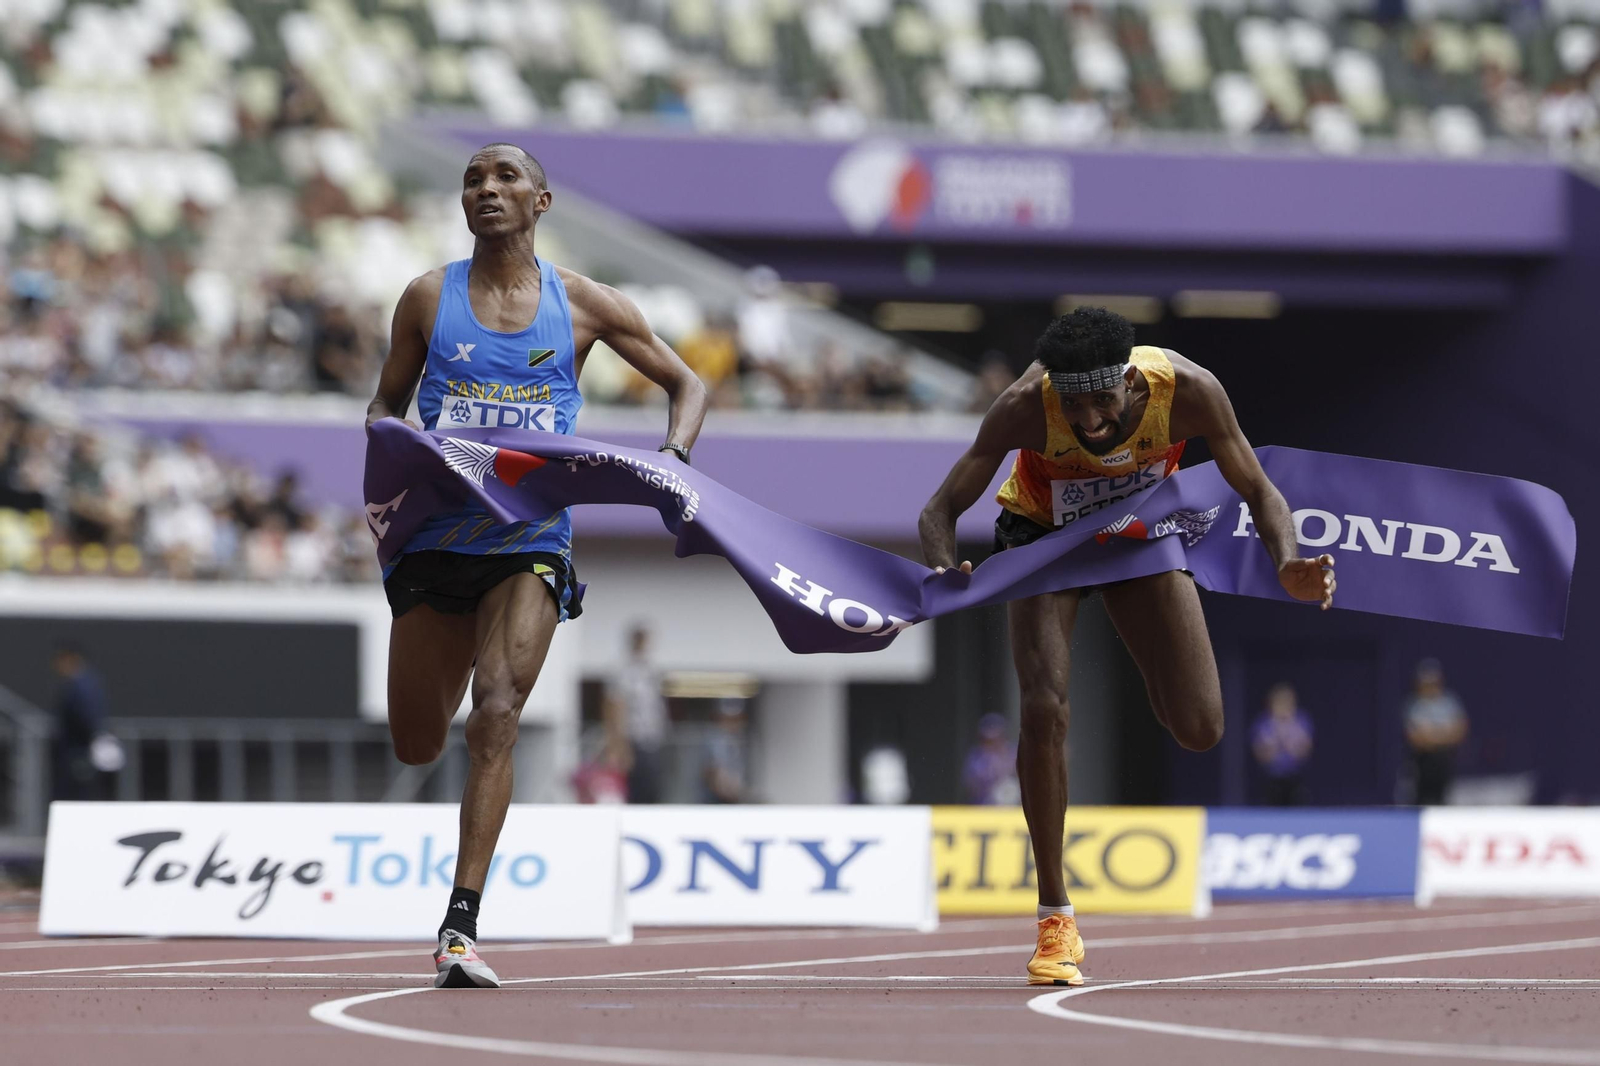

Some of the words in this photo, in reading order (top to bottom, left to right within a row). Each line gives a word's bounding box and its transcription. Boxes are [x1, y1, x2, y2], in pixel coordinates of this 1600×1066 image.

[446, 380, 551, 402] TANZANIA
[472, 401, 547, 431] TDK
[1101, 451, 1131, 464] WGV
[1083, 464, 1156, 498] TDK
[116, 830, 323, 920] Tokyo
